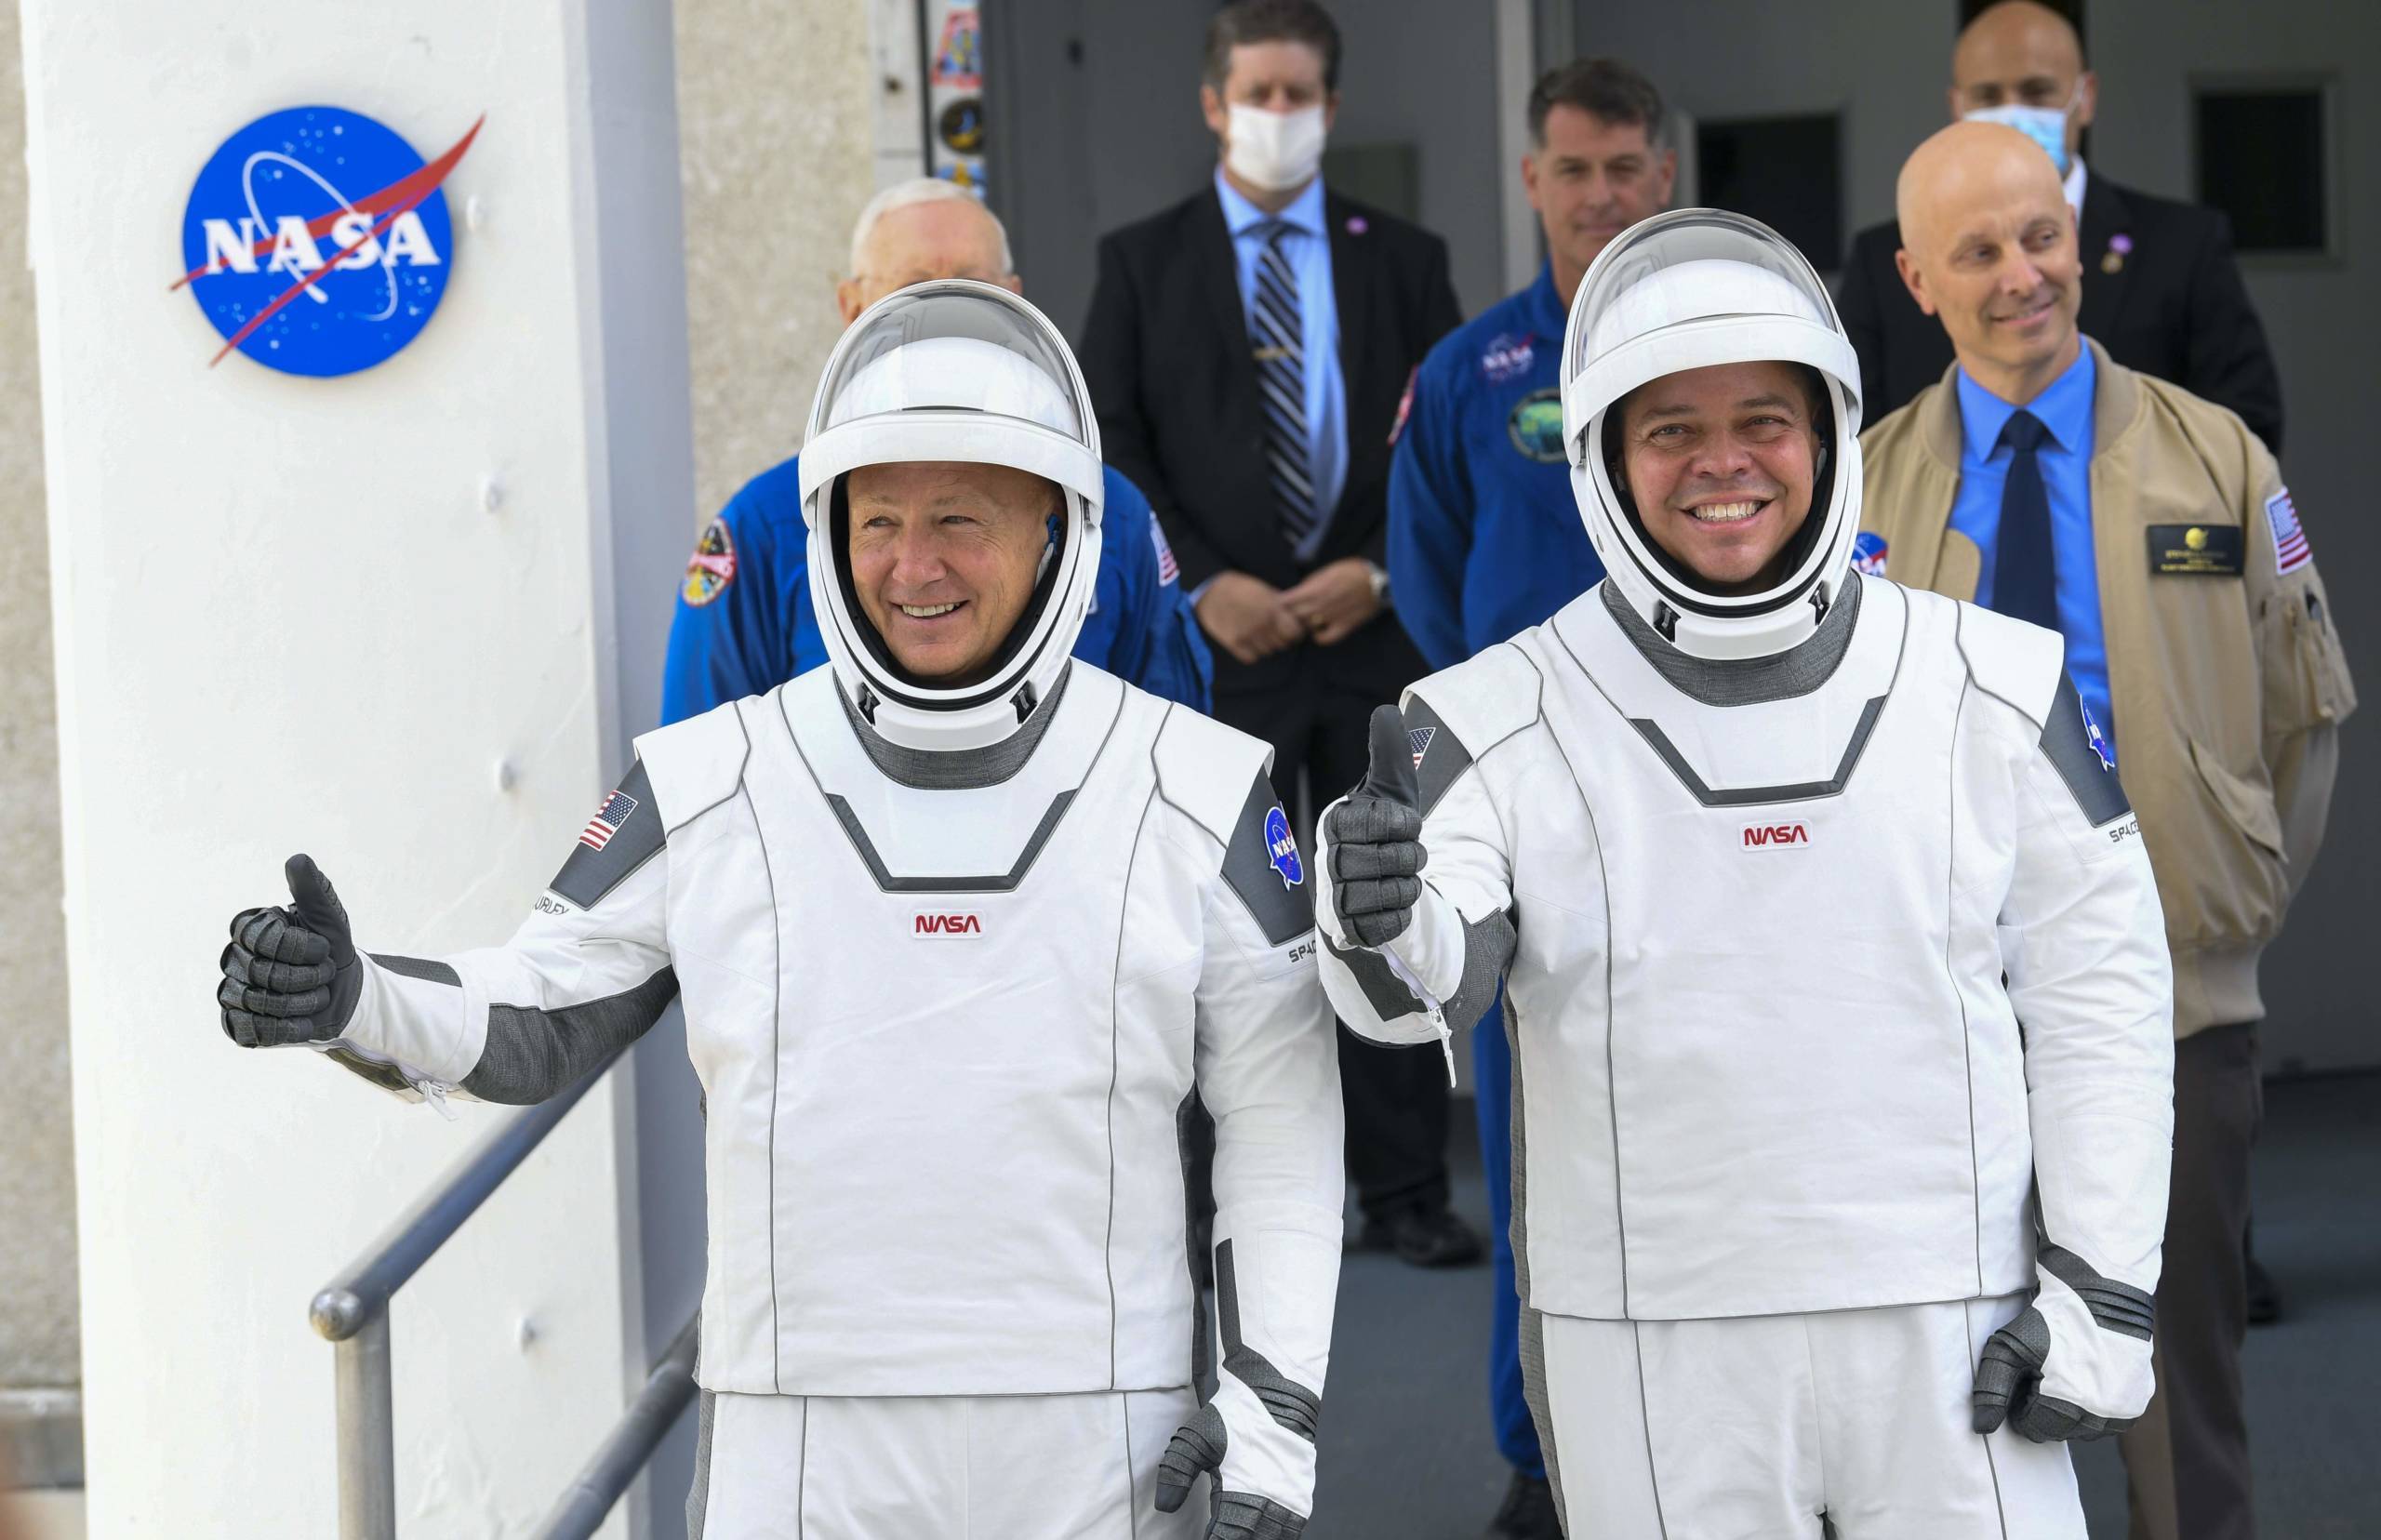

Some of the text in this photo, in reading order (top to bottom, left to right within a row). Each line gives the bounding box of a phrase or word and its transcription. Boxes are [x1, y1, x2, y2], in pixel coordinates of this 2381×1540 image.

[202, 210, 441, 275] NASA
[1744, 825, 1808, 846] NASA
[915, 914, 981, 933] NASA
